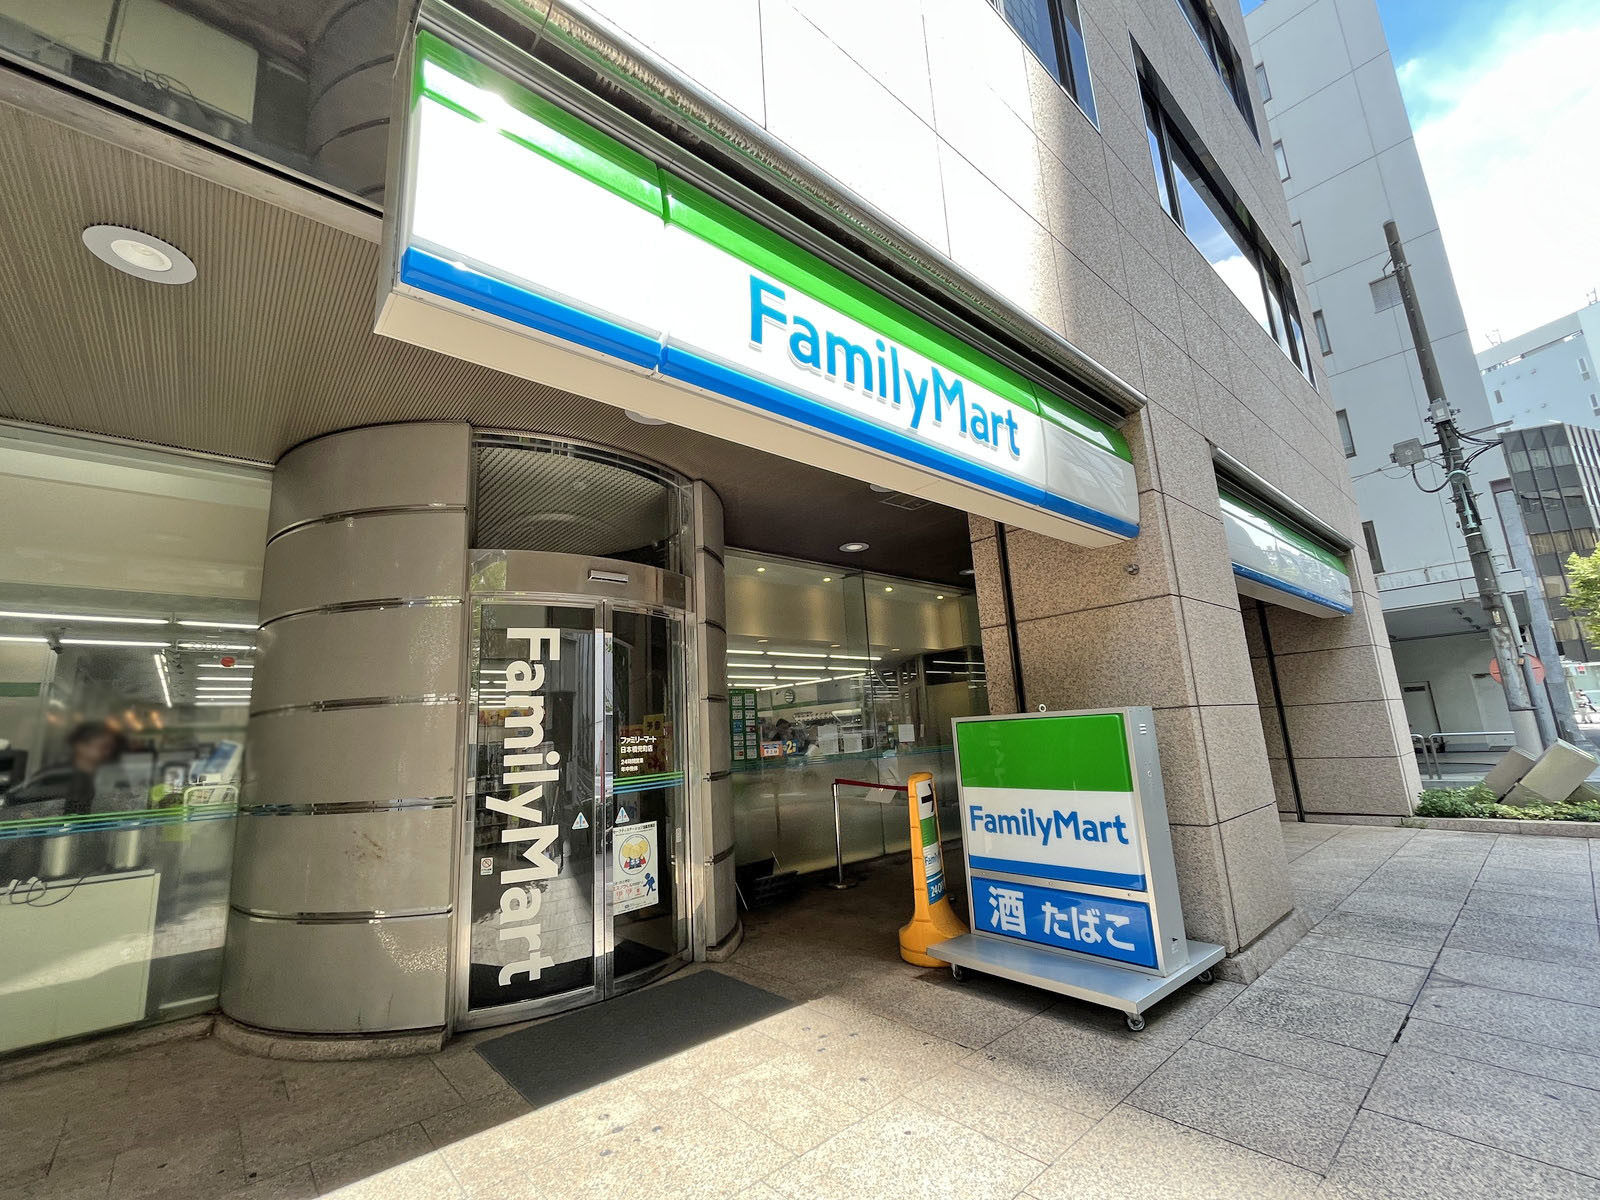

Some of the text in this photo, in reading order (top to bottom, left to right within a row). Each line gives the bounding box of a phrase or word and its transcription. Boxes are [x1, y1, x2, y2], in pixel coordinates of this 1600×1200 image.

[749, 275, 1020, 457] FamilyMart
[620, 736, 656, 744] ファミリーマート
[486, 627, 561, 986] FamilyMart
[969, 805, 1129, 846] FamilyMart
[988, 885, 1135, 952] 酒 たばこ
